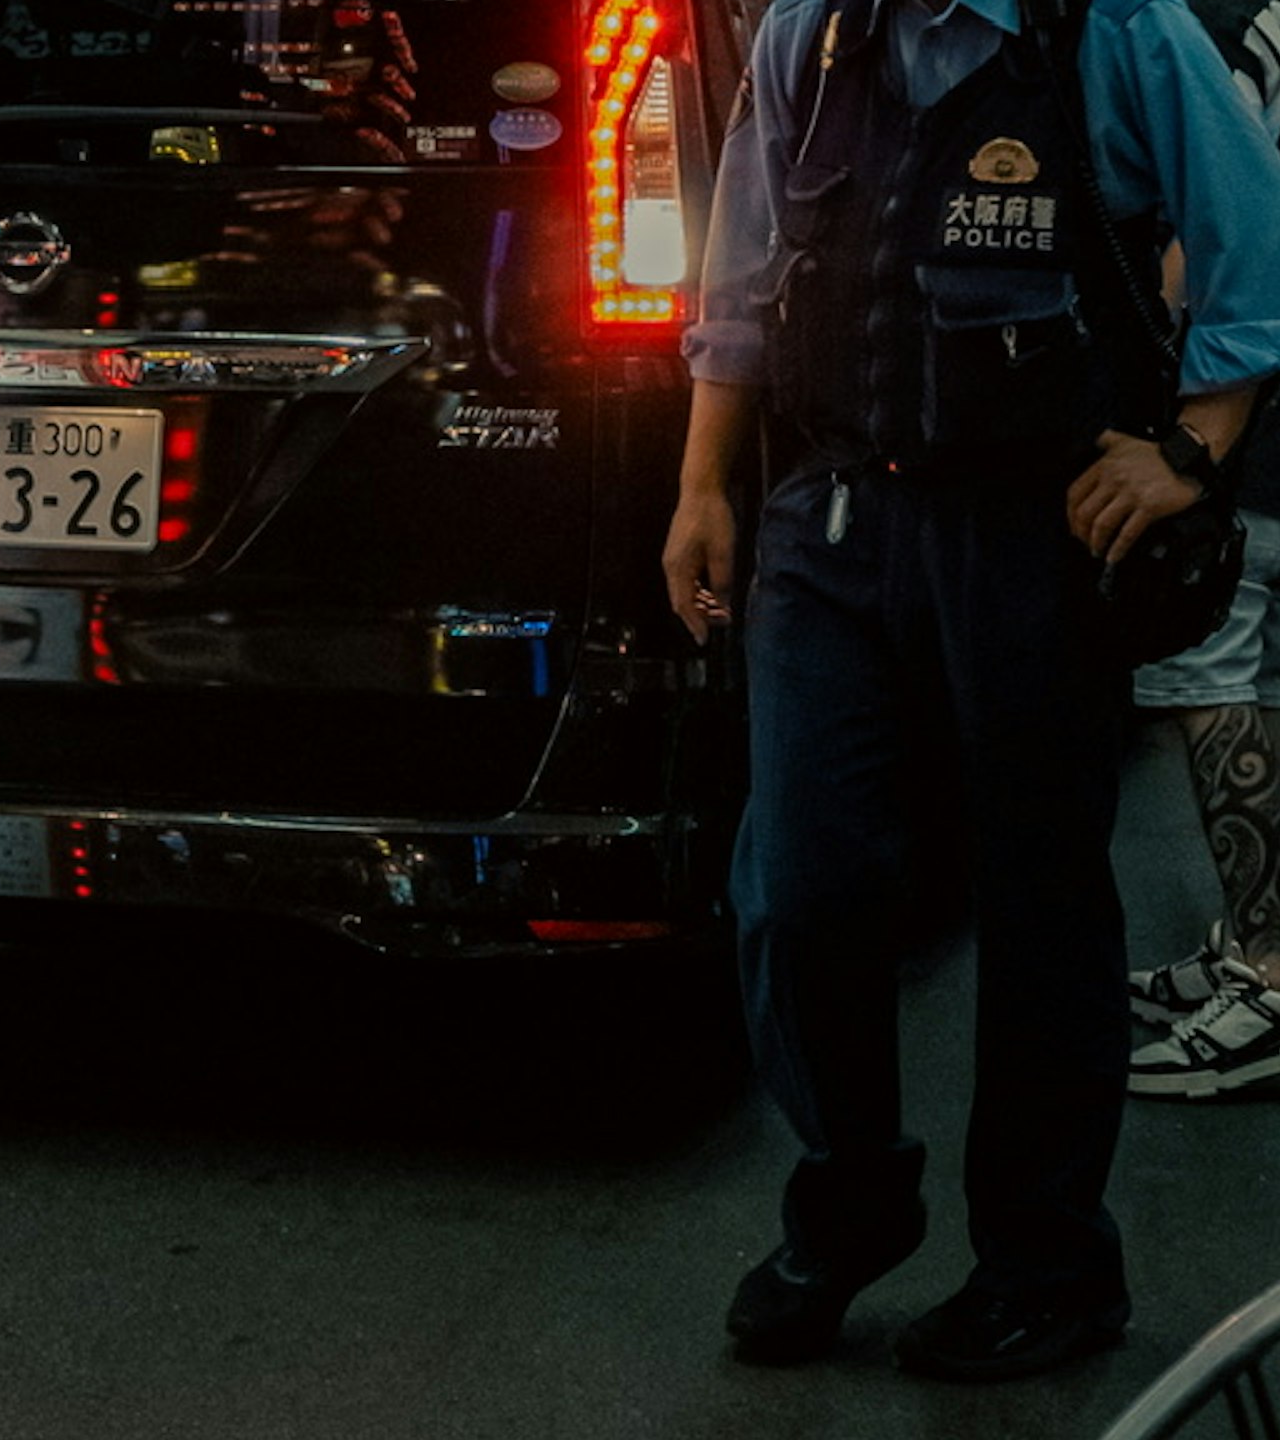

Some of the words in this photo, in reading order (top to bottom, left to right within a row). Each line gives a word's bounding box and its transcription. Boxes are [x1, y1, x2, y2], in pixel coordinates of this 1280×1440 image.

[945, 192, 1057, 229] 大阪府警
[943, 226, 1054, 252] POLICE
[453, 406, 560, 428] Highway
[41, 422, 104, 457] 300
[437, 425, 560, 449] STAR
